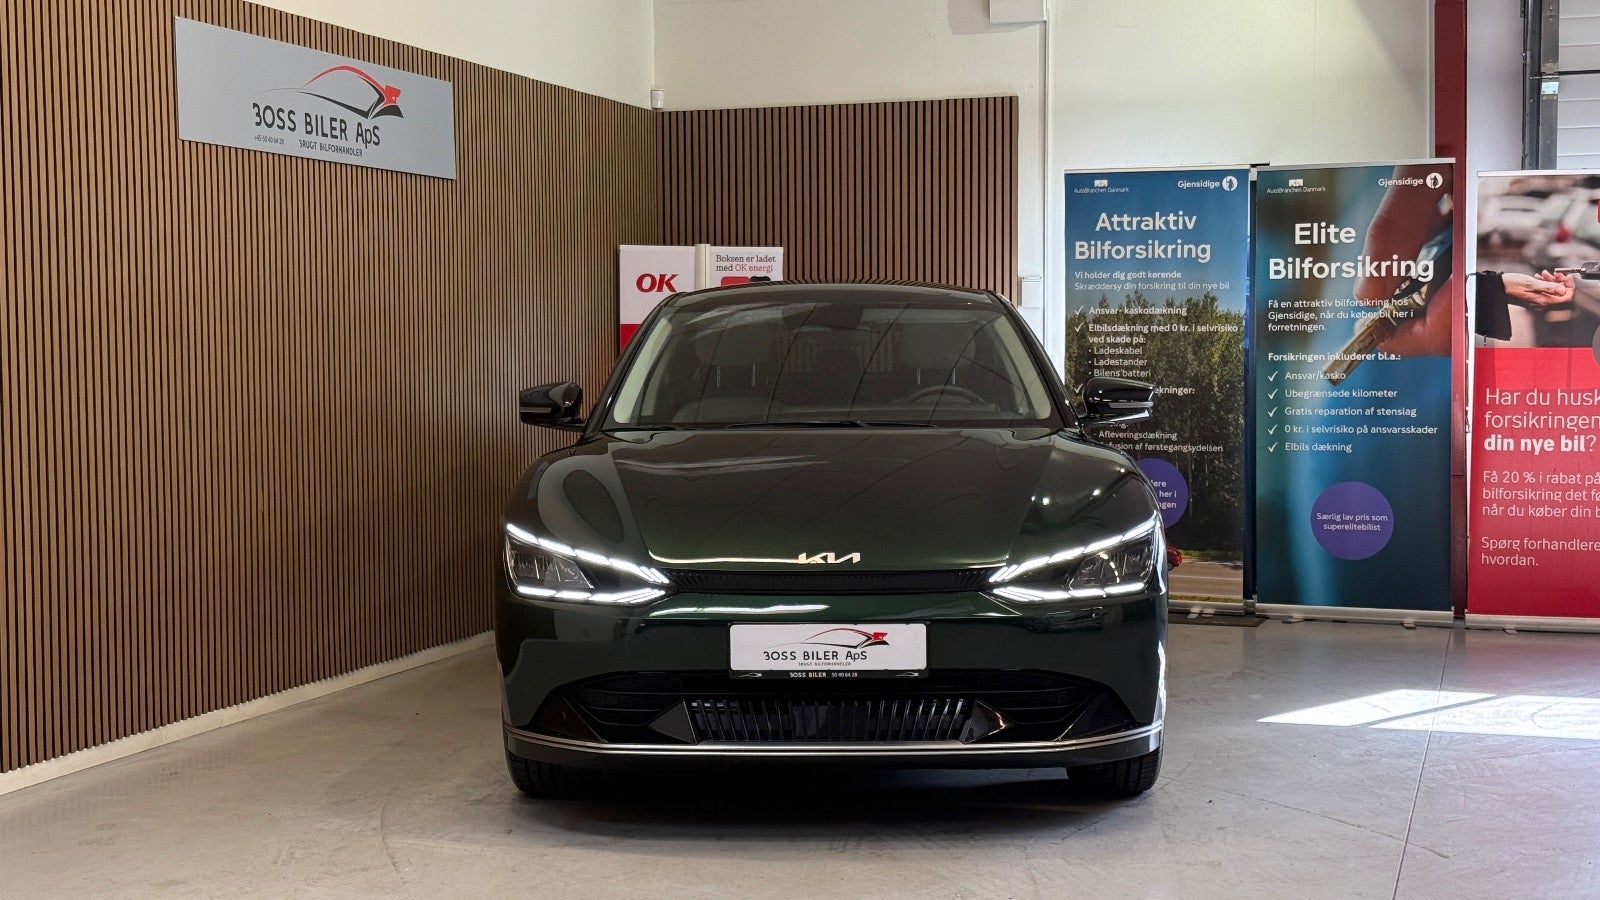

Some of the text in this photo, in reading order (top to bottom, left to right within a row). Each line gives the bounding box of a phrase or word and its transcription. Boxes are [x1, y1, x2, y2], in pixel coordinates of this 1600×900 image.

[304, 112, 348, 141] BILER
[355, 121, 381, 152] ApS
[299, 139, 363, 157] BRUGT BILFORHANDLER
[1178, 180, 1220, 190] Gjensidige
[1378, 177, 1424, 187] Gjensidige
[1095, 210, 1197, 232] Attraktiv
[1294, 222, 1357, 245] Elite
[1075, 239, 1211, 263] Bilforsikring
[715, 254, 745, 263] Boksen
[756, 254, 776, 263] ladet
[715, 263, 774, 274] med OK energi
[1269, 254, 1434, 283] Bilforsikring
[1074, 271, 1182, 281] Vi holder dig godt kørende
[636, 273, 679, 293] OK
[1074, 282, 1230, 292] Skræddersy din forsikring til din nye bil
[1268, 298, 1279, 309] Få
[1293, 299, 1333, 308] attraktiv
[1334, 299, 1390, 309] bilforsikring
[1392, 298, 1409, 307] hos
[1088, 306, 1188, 317] Ansvar- kaskodækning
[1268, 311, 1318, 321] Gjensidige,
[1320, 310, 1335, 319] når
[1336, 310, 1349, 319] du
[1350, 310, 1378, 319] køber
[1379, 310, 1391, 319] bil
[1393, 310, 1408, 318] her
[1088, 323, 1149, 334] Elbilsdækning
[1150, 323, 1171, 332] med
[1171, 323, 1178, 332] 0
[1179, 323, 1191, 332] kr.
[1196, 323, 1238, 332] selvrisiko
[1268, 322, 1327, 333] forretningen.
[1088, 334, 1146, 345] ved skade på:
[1093, 346, 1143, 355] Ladeskabel
[1093, 357, 1148, 366] Ladestander
[1268, 353, 1326, 363] Forsikringen
[1327, 352, 1376, 361] inkluderer
[1093, 369, 1151, 377] Bilens batteri
[1284, 371, 1346, 381] Ansvar/kasko
[1284, 389, 1398, 400] Ubegrænsede kilometer
[1485, 388, 1522, 406] Har
[1525, 388, 1551, 406] du
[1284, 407, 1417, 418] Gratis reparation af stenslag
[1484, 410, 1600, 433] forsikringen
[1284, 425, 1291, 434] 0
[1293, 425, 1304, 434] kr.
[1311, 425, 1355, 434] selvrisiko
[1356, 425, 1369, 436] på
[1370, 425, 1438, 435] ansvarsskader
[1134, 442, 1144, 450] af
[1285, 443, 1353, 454] Elbils dækning
[1483, 434, 1597, 455] din nye bil?
[1483, 470, 1498, 484] Få
[1502, 471, 1520, 484] 20
[1523, 471, 1536, 484] %
[1546, 472, 1582, 485] rabat
[1159, 490, 1173, 498] her
[1482, 487, 1562, 503] bilforsikring
[1565, 488, 1588, 501] det
[1482, 503, 1505, 516] når
[1507, 504, 1524, 517] du
[1528, 504, 1568, 518] køber
[1570, 505, 1592, 518] din
[1316, 512, 1341, 522] Særlig
[1342, 512, 1354, 521] lav
[1355, 513, 1370, 523] pris
[1323, 522, 1382, 532] superelitebilist
[1481, 536, 1520, 552] Spørg
[798, 552, 861, 564] KIA
[1481, 553, 1539, 567] hvordan.
[803, 650, 839, 661] BILER
[845, 650, 868, 662] ApS
